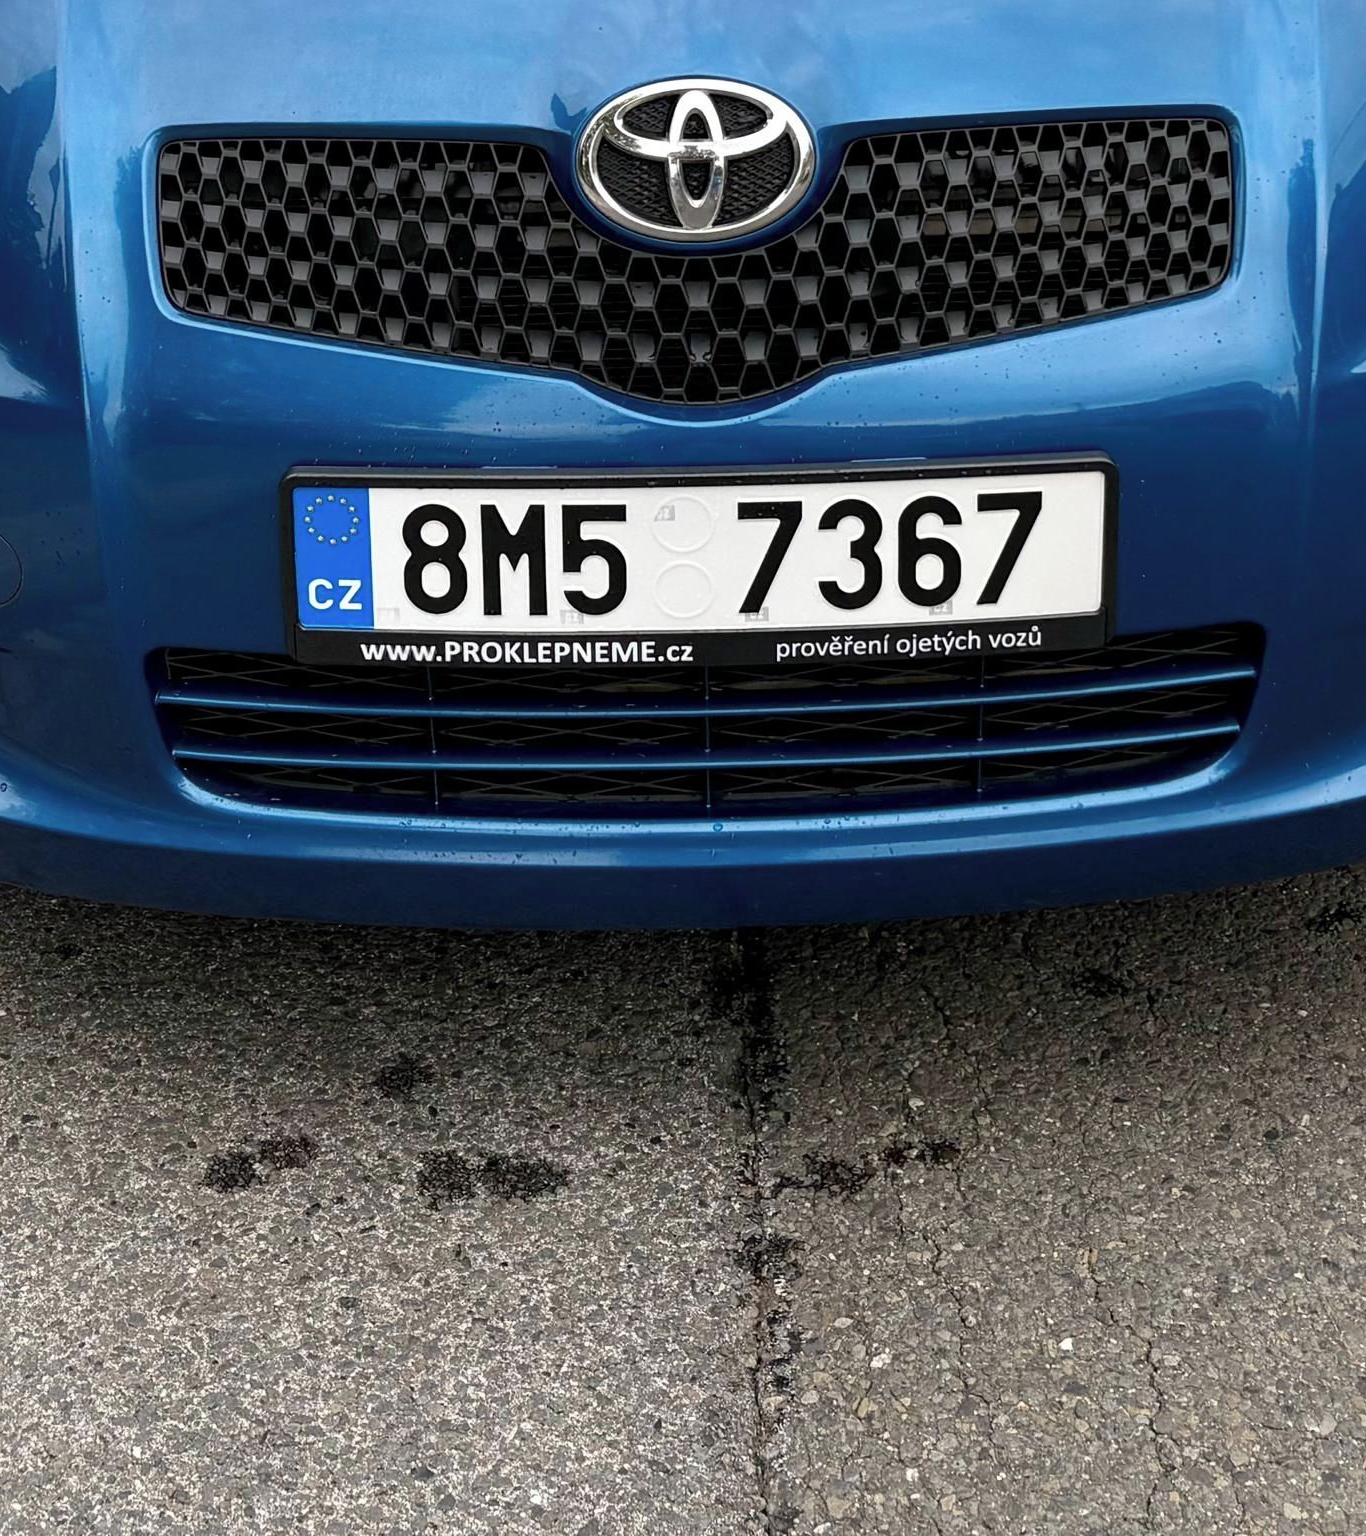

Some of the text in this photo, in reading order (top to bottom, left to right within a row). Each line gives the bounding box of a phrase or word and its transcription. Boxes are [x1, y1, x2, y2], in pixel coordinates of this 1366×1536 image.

[402, 490, 1043, 615] 8M5 7367
[308, 578, 363, 610] CZ
[360, 641, 694, 663] www.PROKLEPNEME.cz
[776, 625, 1042, 662] prověření ojetých vozů
